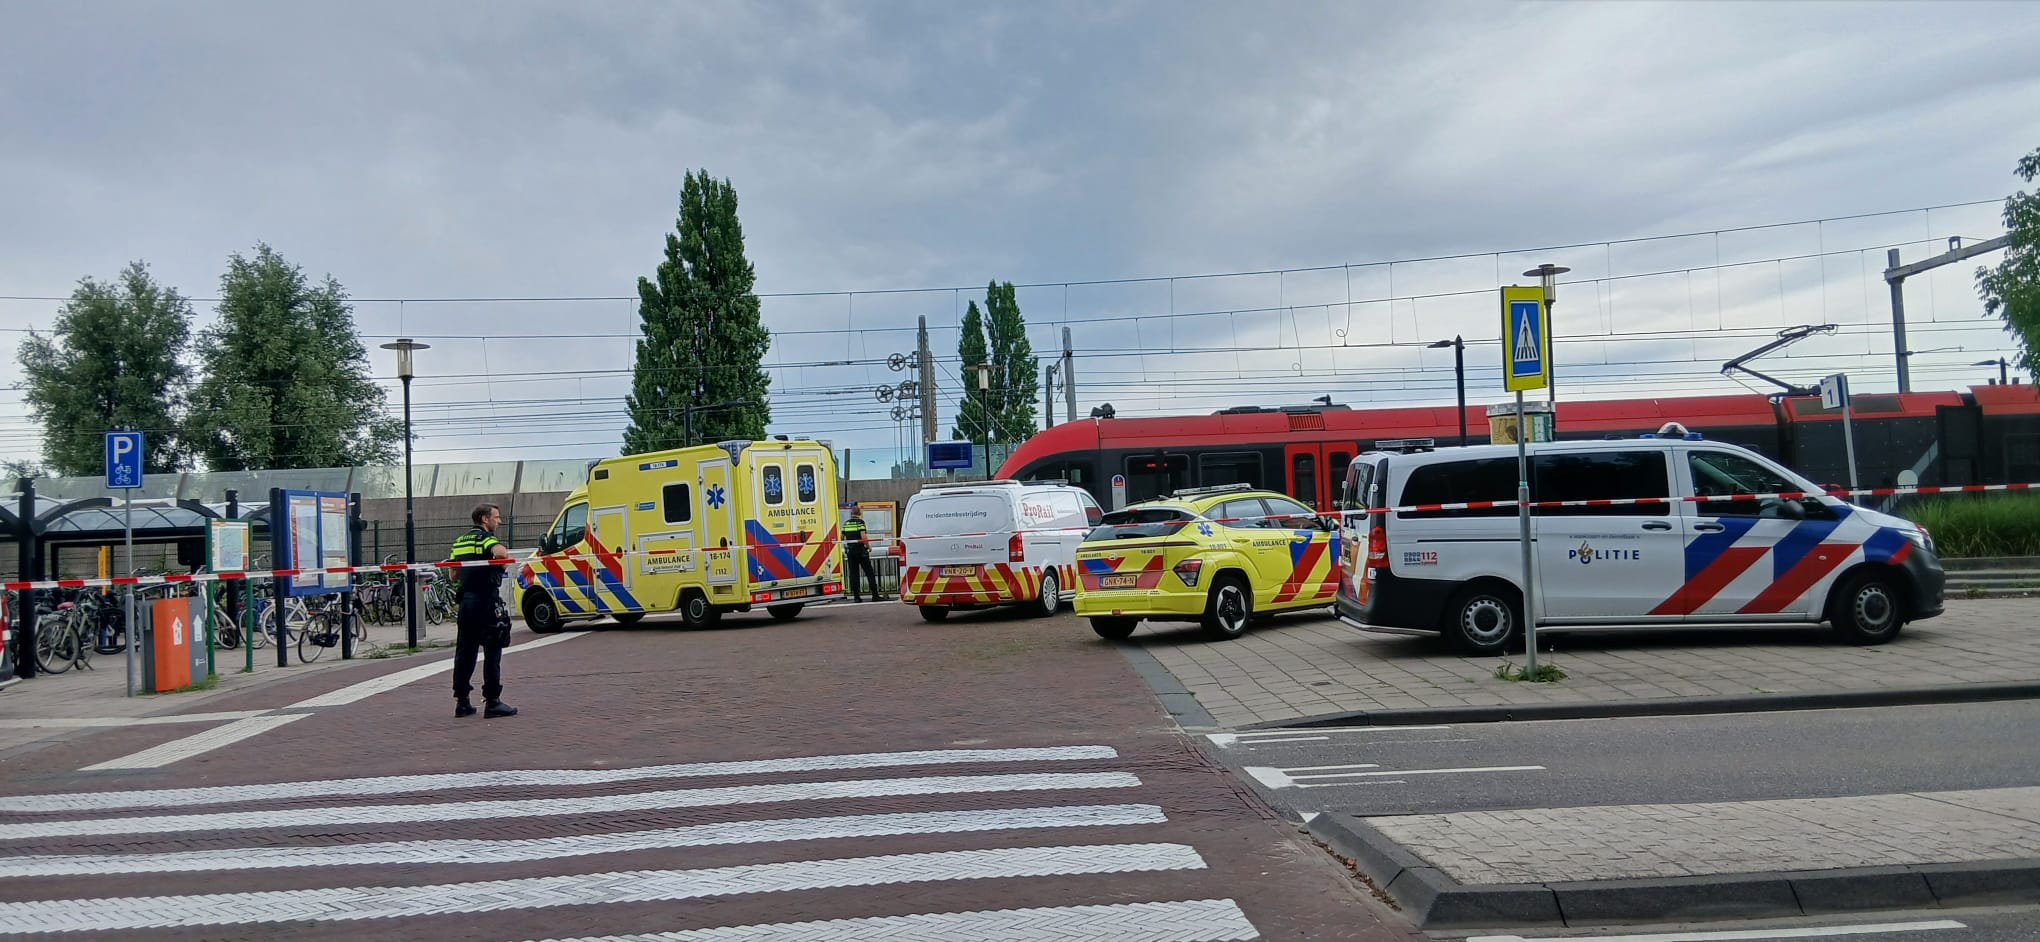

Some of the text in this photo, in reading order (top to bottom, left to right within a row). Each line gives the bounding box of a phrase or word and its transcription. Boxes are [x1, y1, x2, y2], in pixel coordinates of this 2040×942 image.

[1827, 388, 1834, 405] 1
[114, 436, 133, 464] P
[768, 507, 815, 517] AMBULANCE
[925, 509, 987, 519] Incidentenbestrijding
[1022, 503, 1055, 519] ProRail
[1252, 539, 1286, 547] AMBULANCE
[647, 554, 690, 566] AMBULANCE
[709, 552, 731, 560] 18-174
[1421, 552, 1438, 560] 112
[1569, 549, 1640, 564] POLITIE
[1104, 575, 1135, 586] GNK-74-N
